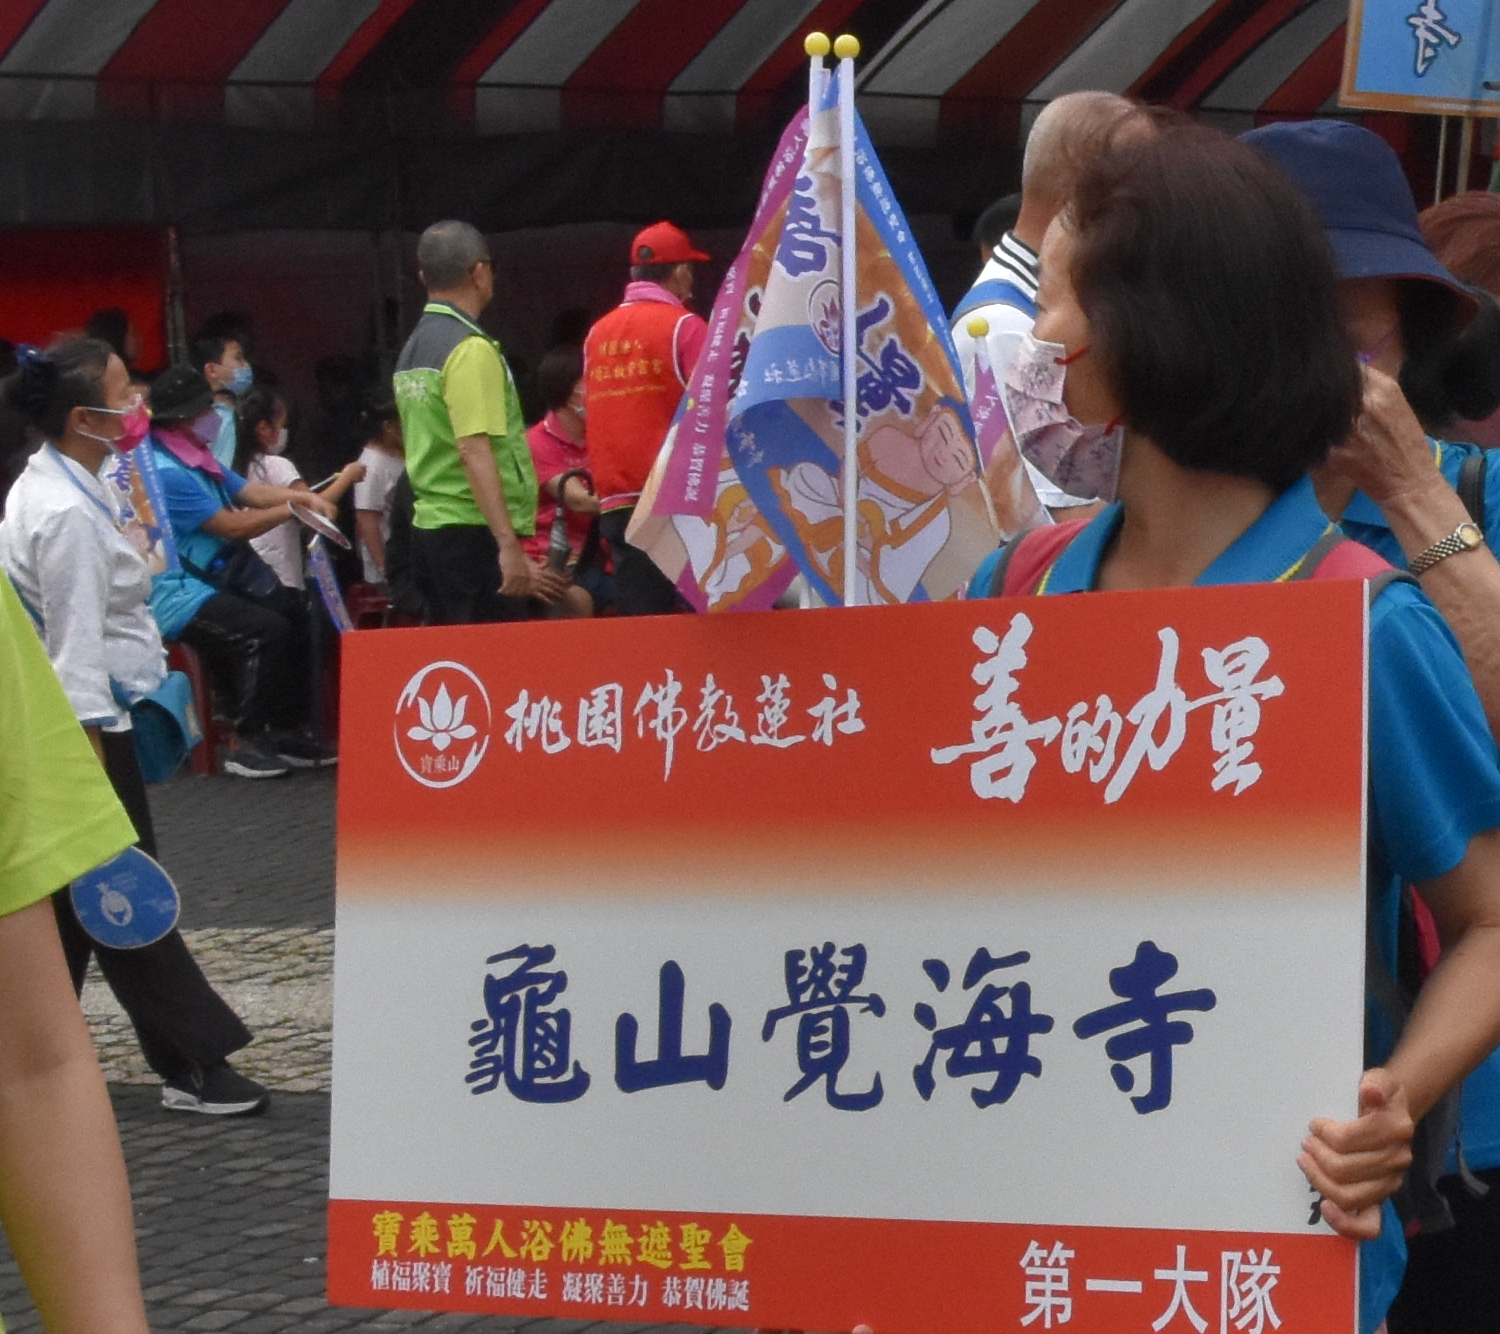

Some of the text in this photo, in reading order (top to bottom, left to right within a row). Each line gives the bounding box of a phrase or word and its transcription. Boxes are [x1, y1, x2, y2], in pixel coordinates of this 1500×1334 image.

[504, 612, 1286, 804] 桃園佛教蓮社 善的力量
[466, 941, 1217, 1115] 龜山覺海寺
[370, 1258, 750, 1313] 植福聚寶 祈福健走 凝聚善力 恭賀佛誕
[372, 1210, 753, 1272] 寶乘萬人浴佛無遮聖會
